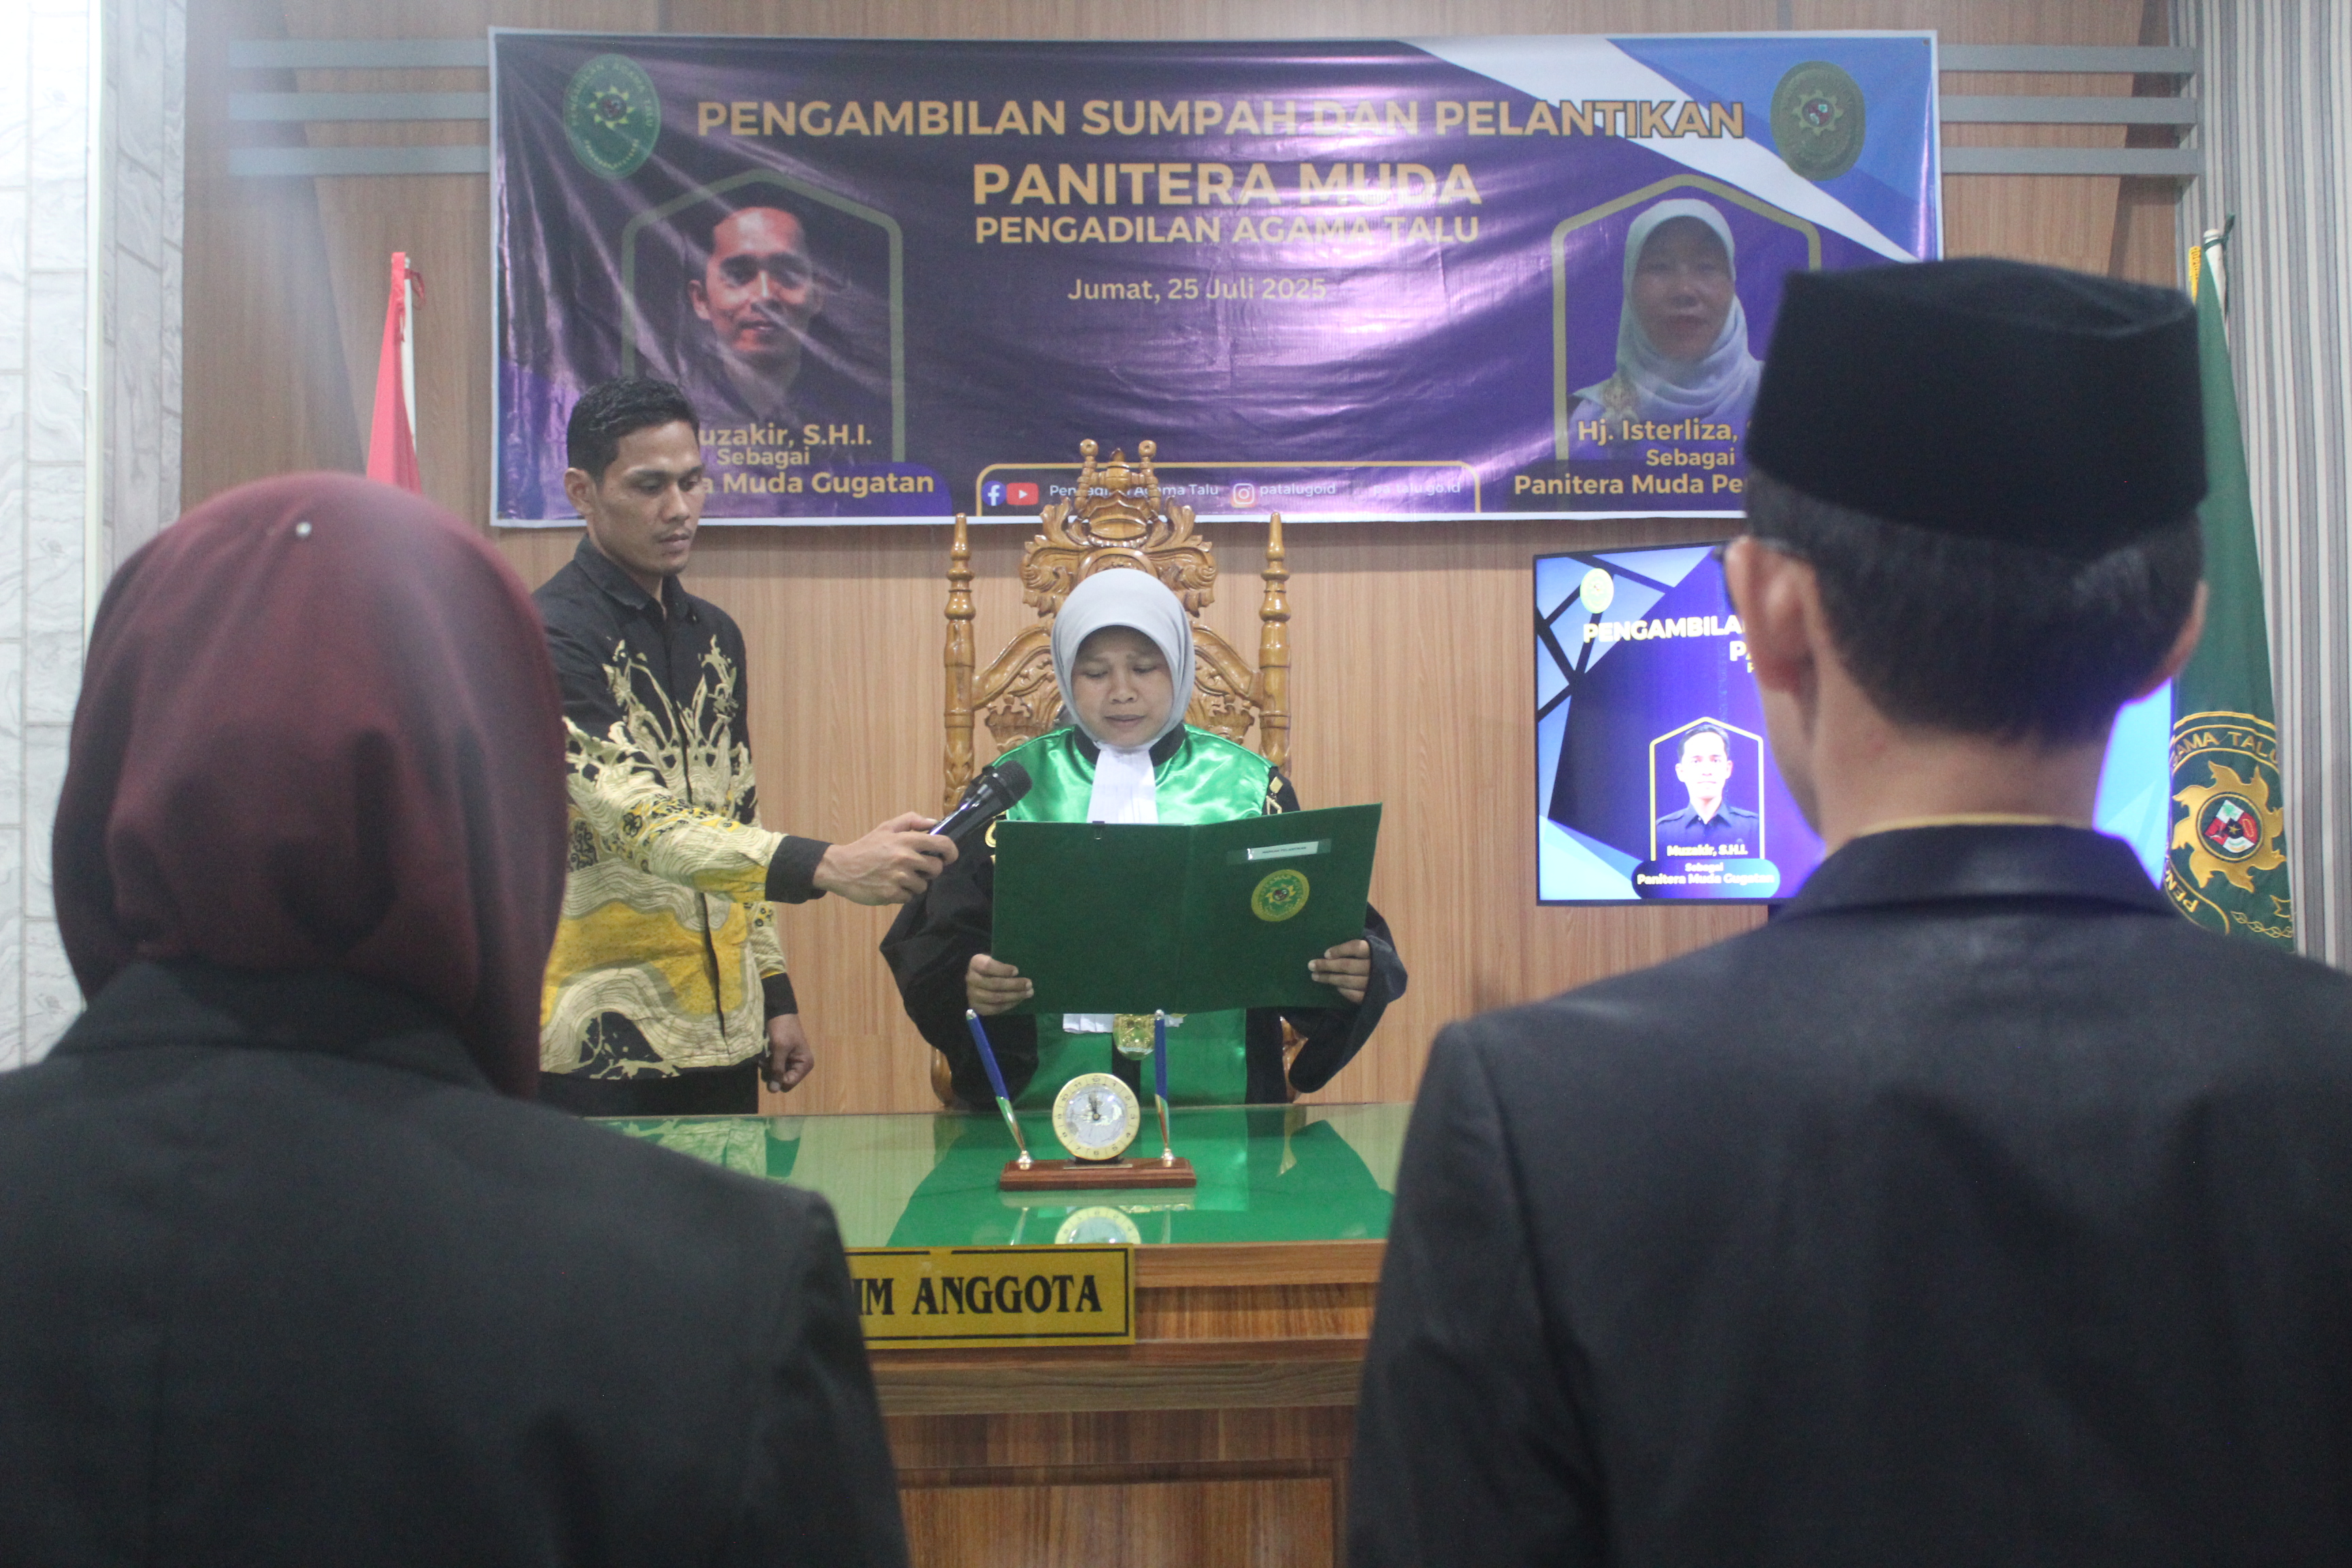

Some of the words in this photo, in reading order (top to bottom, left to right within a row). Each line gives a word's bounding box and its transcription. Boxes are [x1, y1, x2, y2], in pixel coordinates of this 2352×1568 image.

[698, 100, 1065, 136] PENGAMBILAN
[1081, 99, 1296, 135] SUMPAH
[1313, 100, 1418, 135] DAN
[1435, 99, 1745, 137] PELANTIKAN
[973, 163, 1281, 205] PANITERA
[1299, 163, 1482, 205] MUDA
[976, 216, 1221, 244] PENGADILAN
[1231, 215, 1375, 243] AGAMA
[1383, 216, 1480, 243] TALU
[1067, 278, 1160, 304] Jumat,
[1167, 278, 1200, 299] 25
[1206, 277, 1254, 299] Juli
[1262, 278, 1327, 299] 2025
[698, 422, 795, 448] uzakir,
[802, 424, 872, 445] S.H.I.
[1578, 418, 1614, 446] Hj.
[1622, 417, 1738, 442] Isterliza,
[717, 446, 811, 470] Sebagai
[1646, 446, 1735, 470] Sebagai
[723, 472, 804, 494] Muda
[811, 472, 934, 498] Gugatan
[1188, 483, 1219, 496] Talu
[1259, 483, 1337, 497] patalugoid
[1514, 473, 1624, 495] Panitera
[1631, 474, 1704, 494] Muda
[1583, 614, 1746, 643] PENGAMBILA
[1636, 872, 1687, 885] Panitera
[1687, 872, 1722, 884] Muda
[911, 1274, 1103, 1315] ANGGOTA
